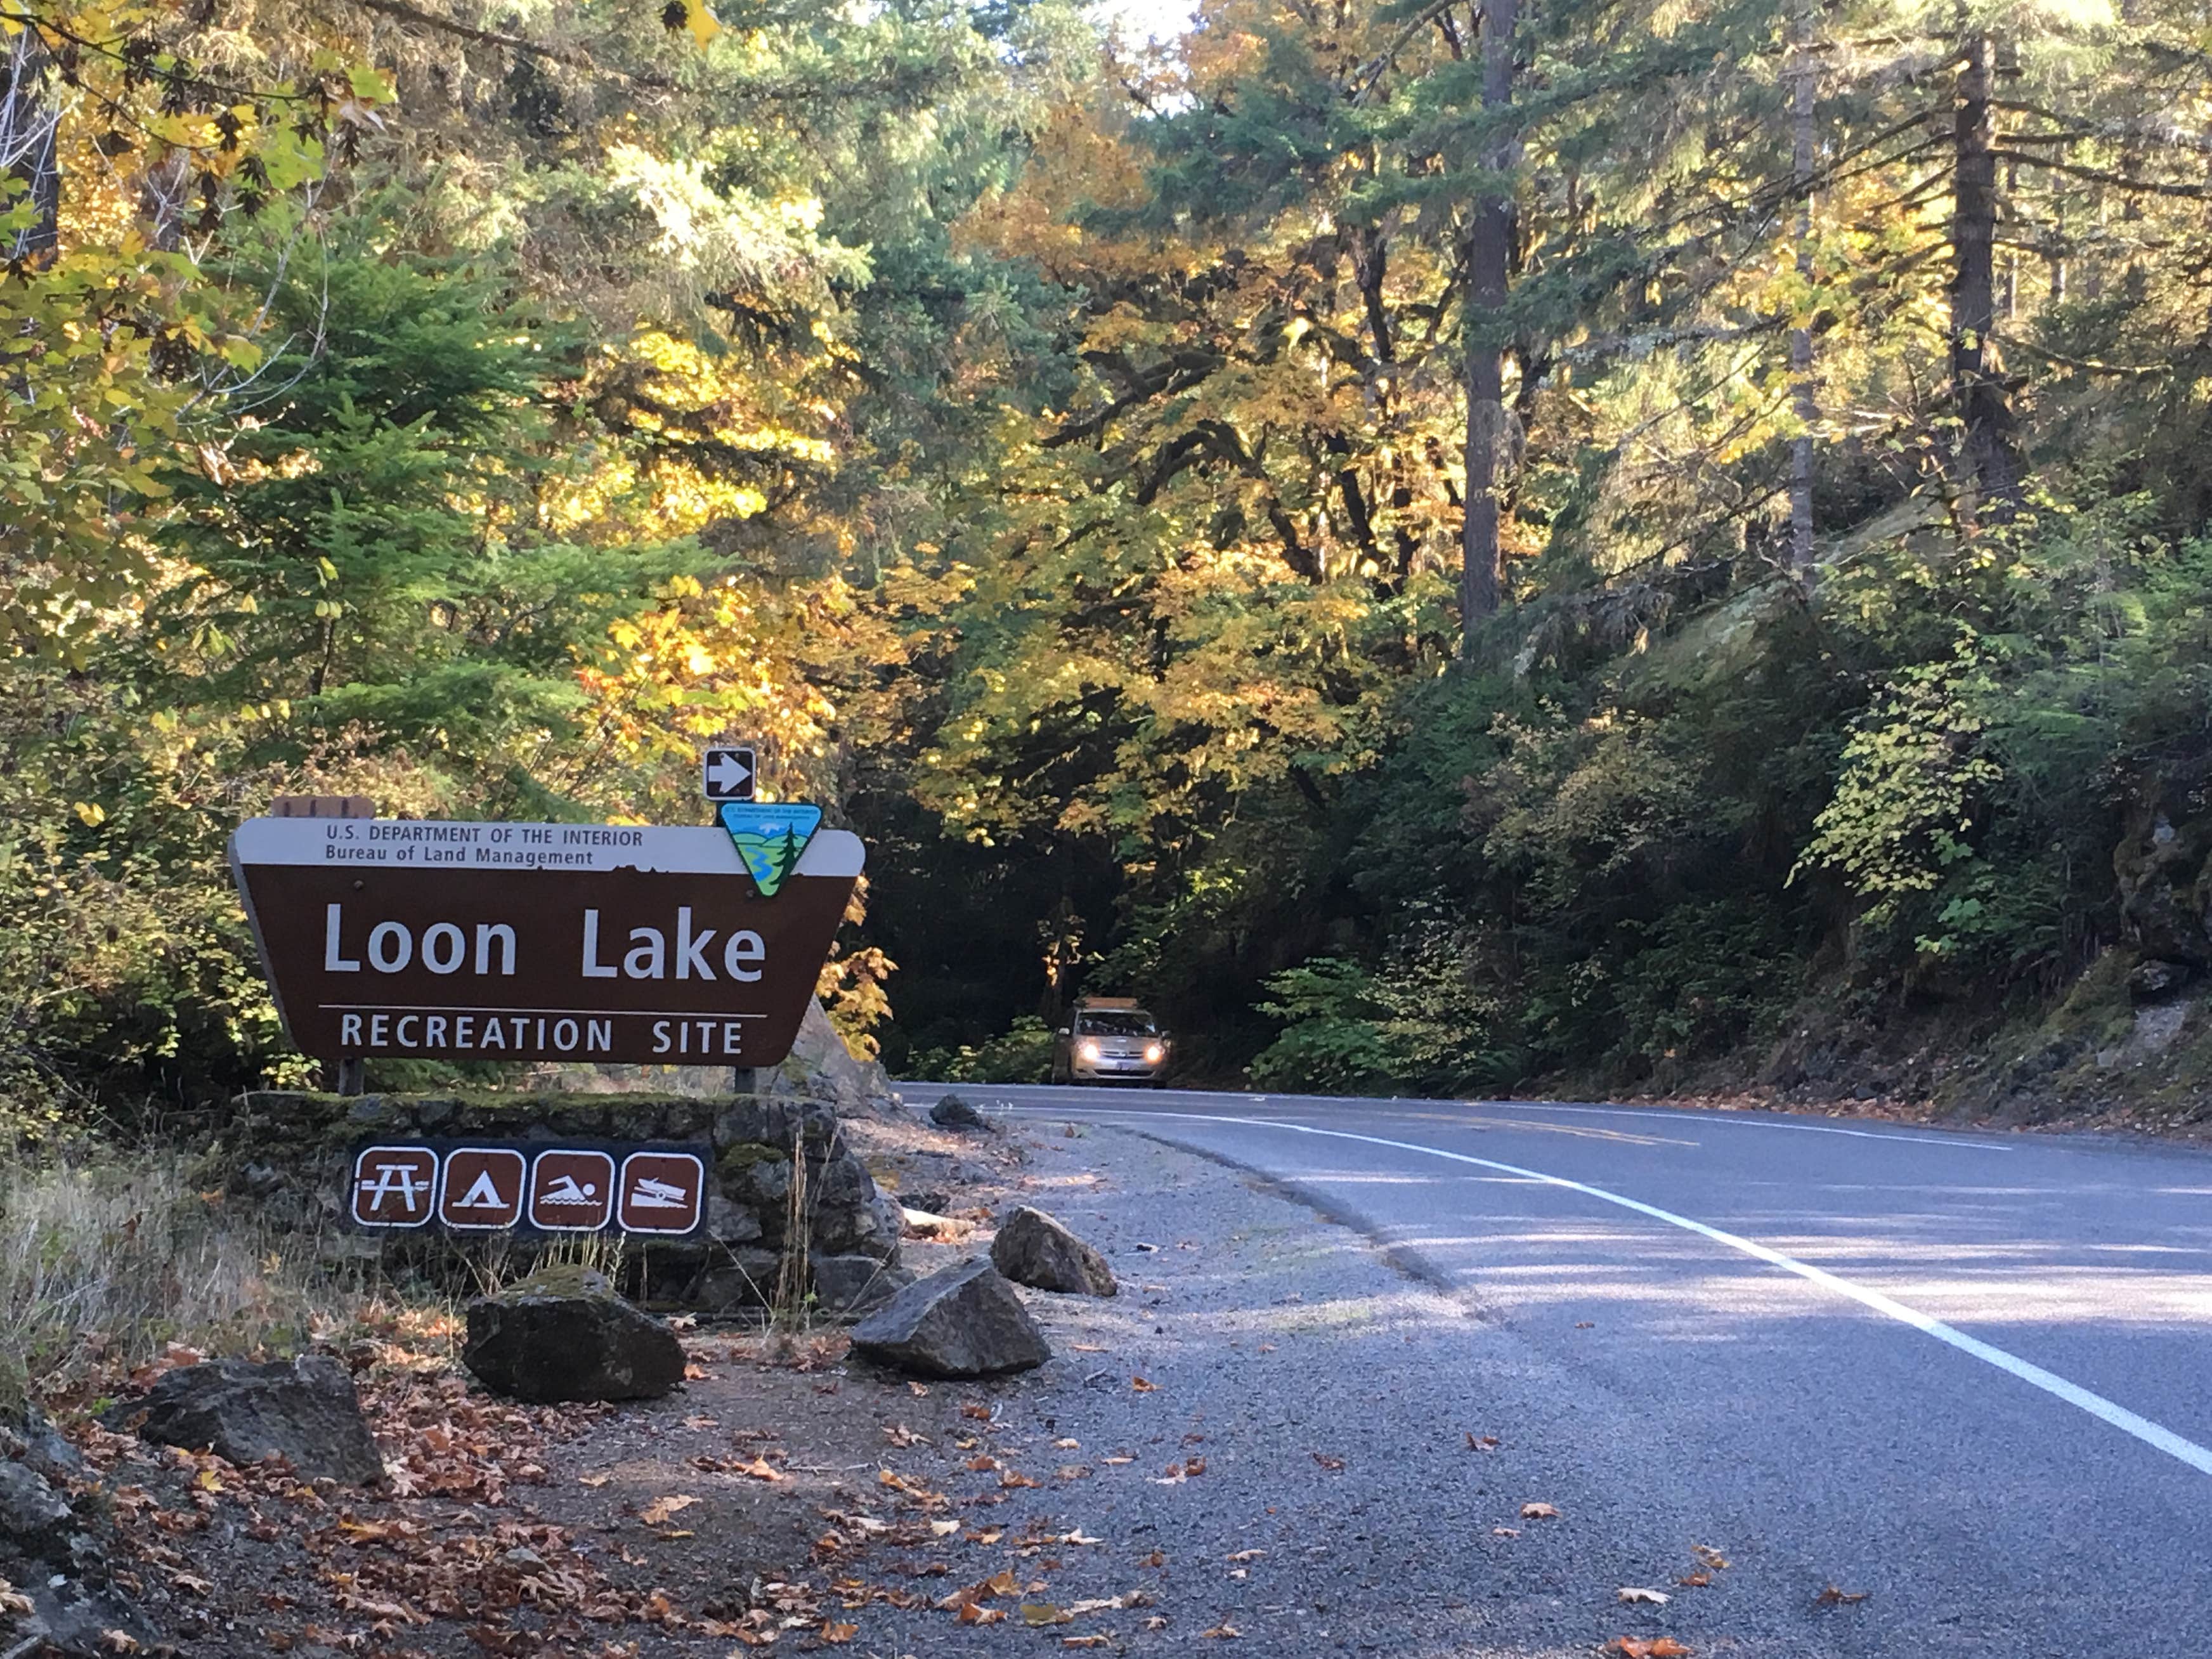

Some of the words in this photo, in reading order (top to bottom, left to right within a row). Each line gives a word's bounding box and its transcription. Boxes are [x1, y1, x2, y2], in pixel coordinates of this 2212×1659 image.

[327, 824, 360, 840] U.S.
[369, 826, 481, 842] DEPARTMENT
[490, 828, 513, 843] OF
[521, 829, 552, 843] THE
[563, 829, 643, 846] INTERIOR
[325, 845, 387, 859] Bureau
[396, 845, 415, 861] of
[424, 847, 466, 861] Land
[476, 848, 593, 867] Management
[325, 903, 516, 975] Loon
[582, 906, 765, 982] Lake
[341, 1015, 611, 1052] RECREATION
[652, 1020, 741, 1054] SITE
